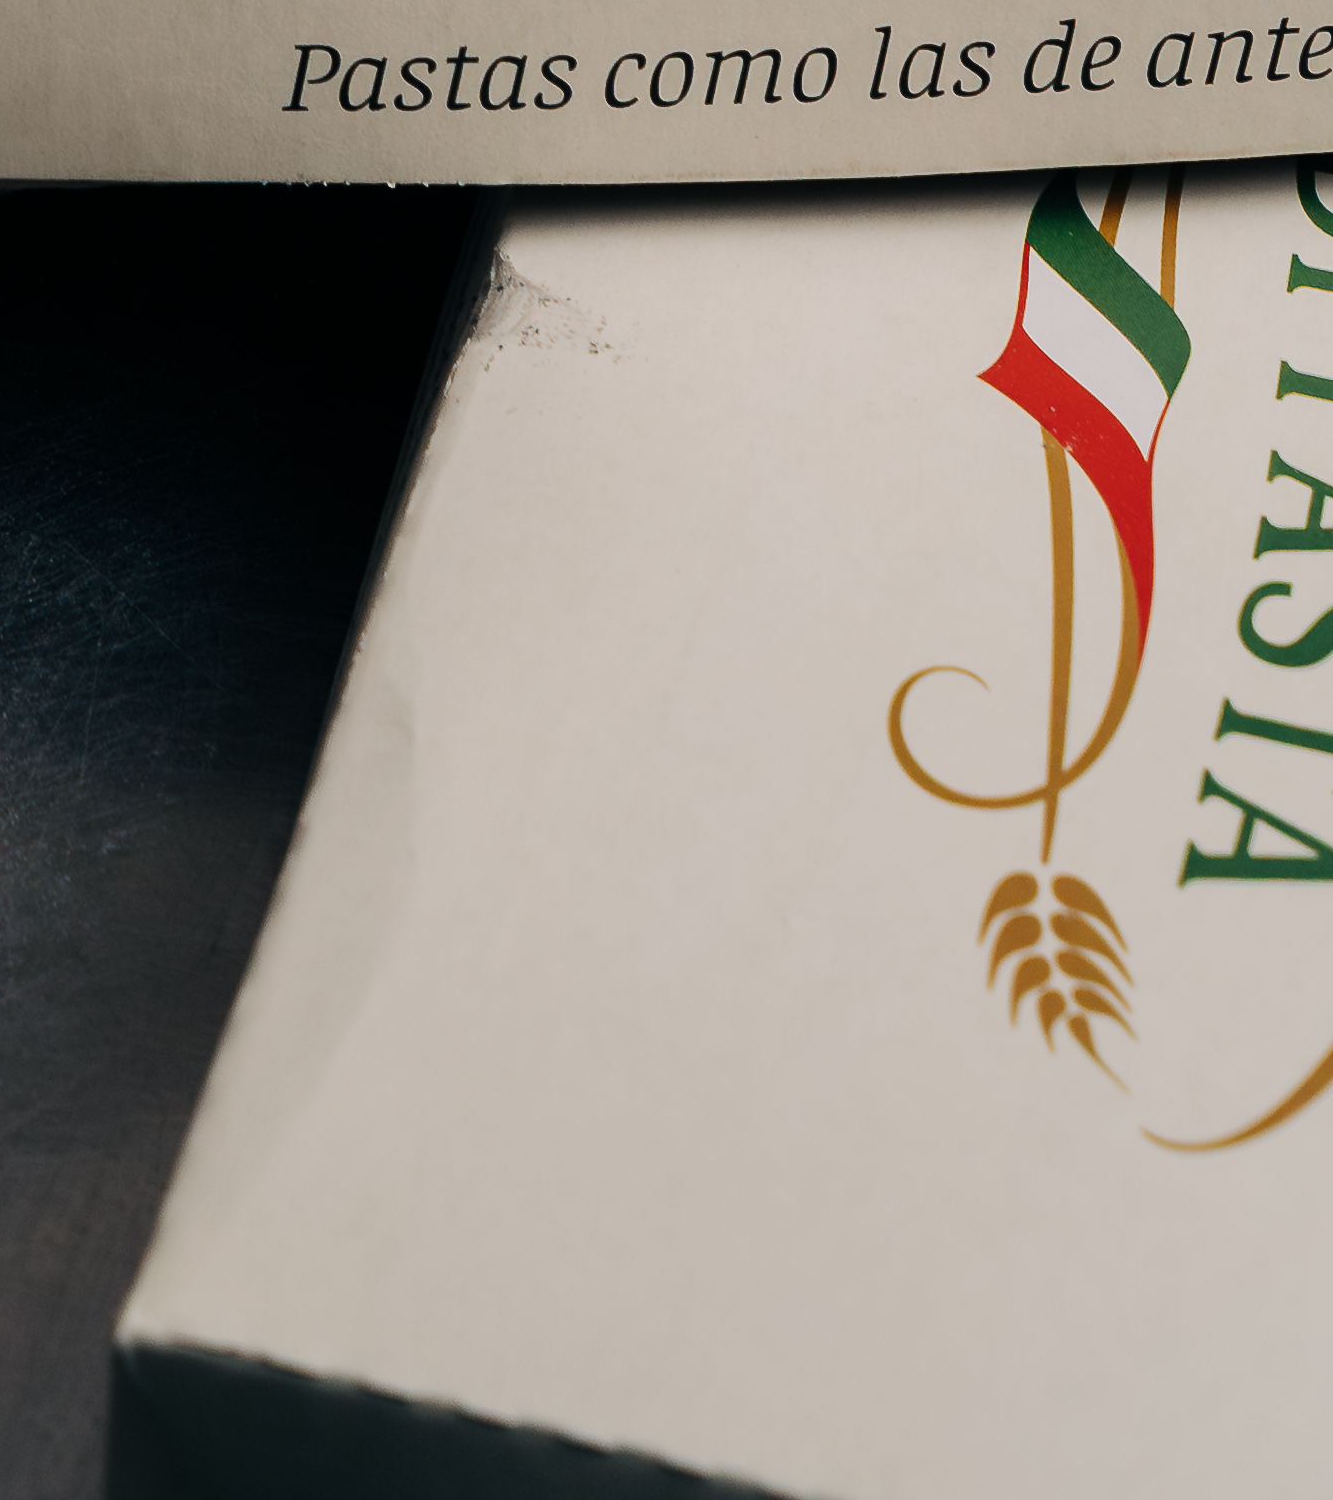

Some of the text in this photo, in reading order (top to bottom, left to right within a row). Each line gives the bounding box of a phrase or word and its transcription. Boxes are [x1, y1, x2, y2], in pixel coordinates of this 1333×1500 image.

[280, 42, 577, 114] Pastas
[603, 46, 839, 108] como
[868, 24, 996, 99] las
[1022, 17, 1123, 96] de
